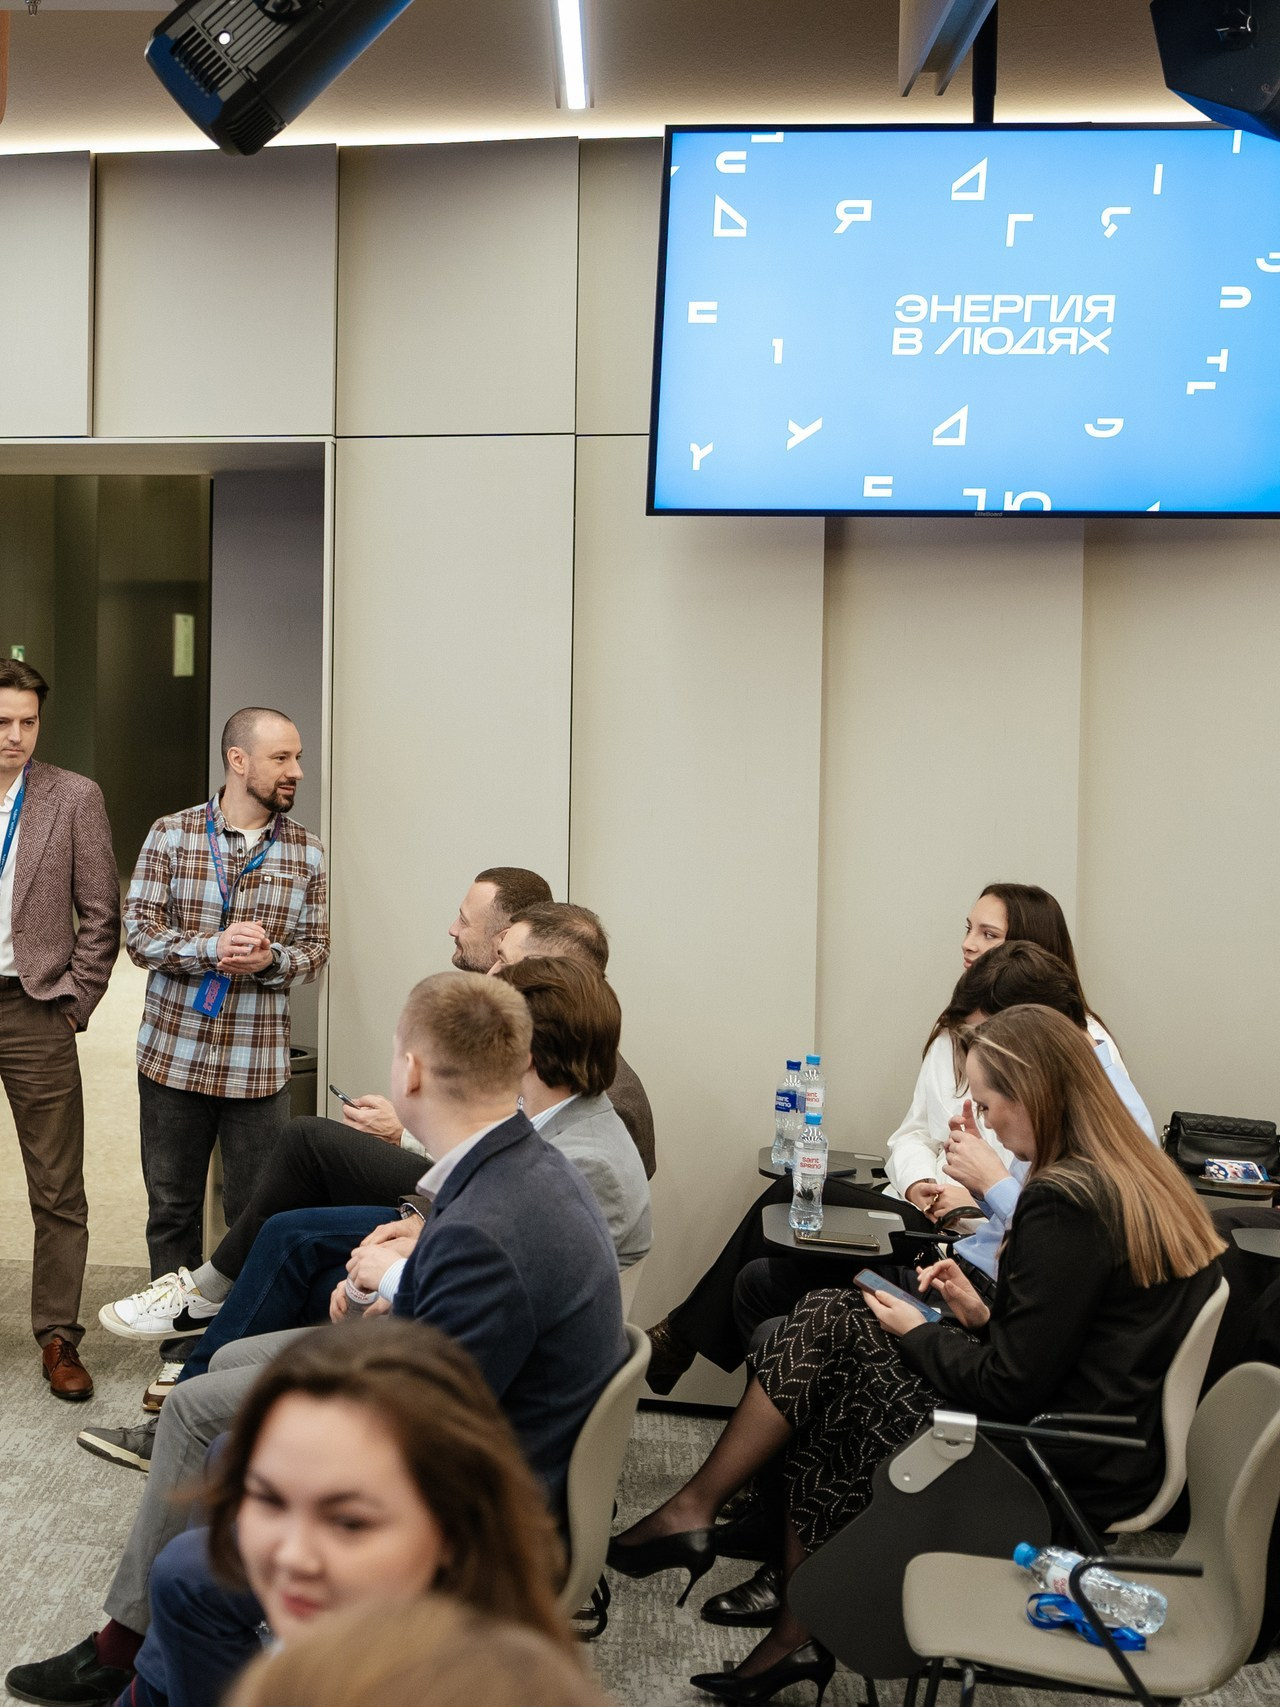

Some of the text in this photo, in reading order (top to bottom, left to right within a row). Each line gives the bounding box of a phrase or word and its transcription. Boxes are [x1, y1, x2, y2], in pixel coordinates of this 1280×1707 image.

[894, 293, 1116, 323] ЭНЕРГИЯ
[891, 326, 1112, 356] В ЛЮДЯХ
